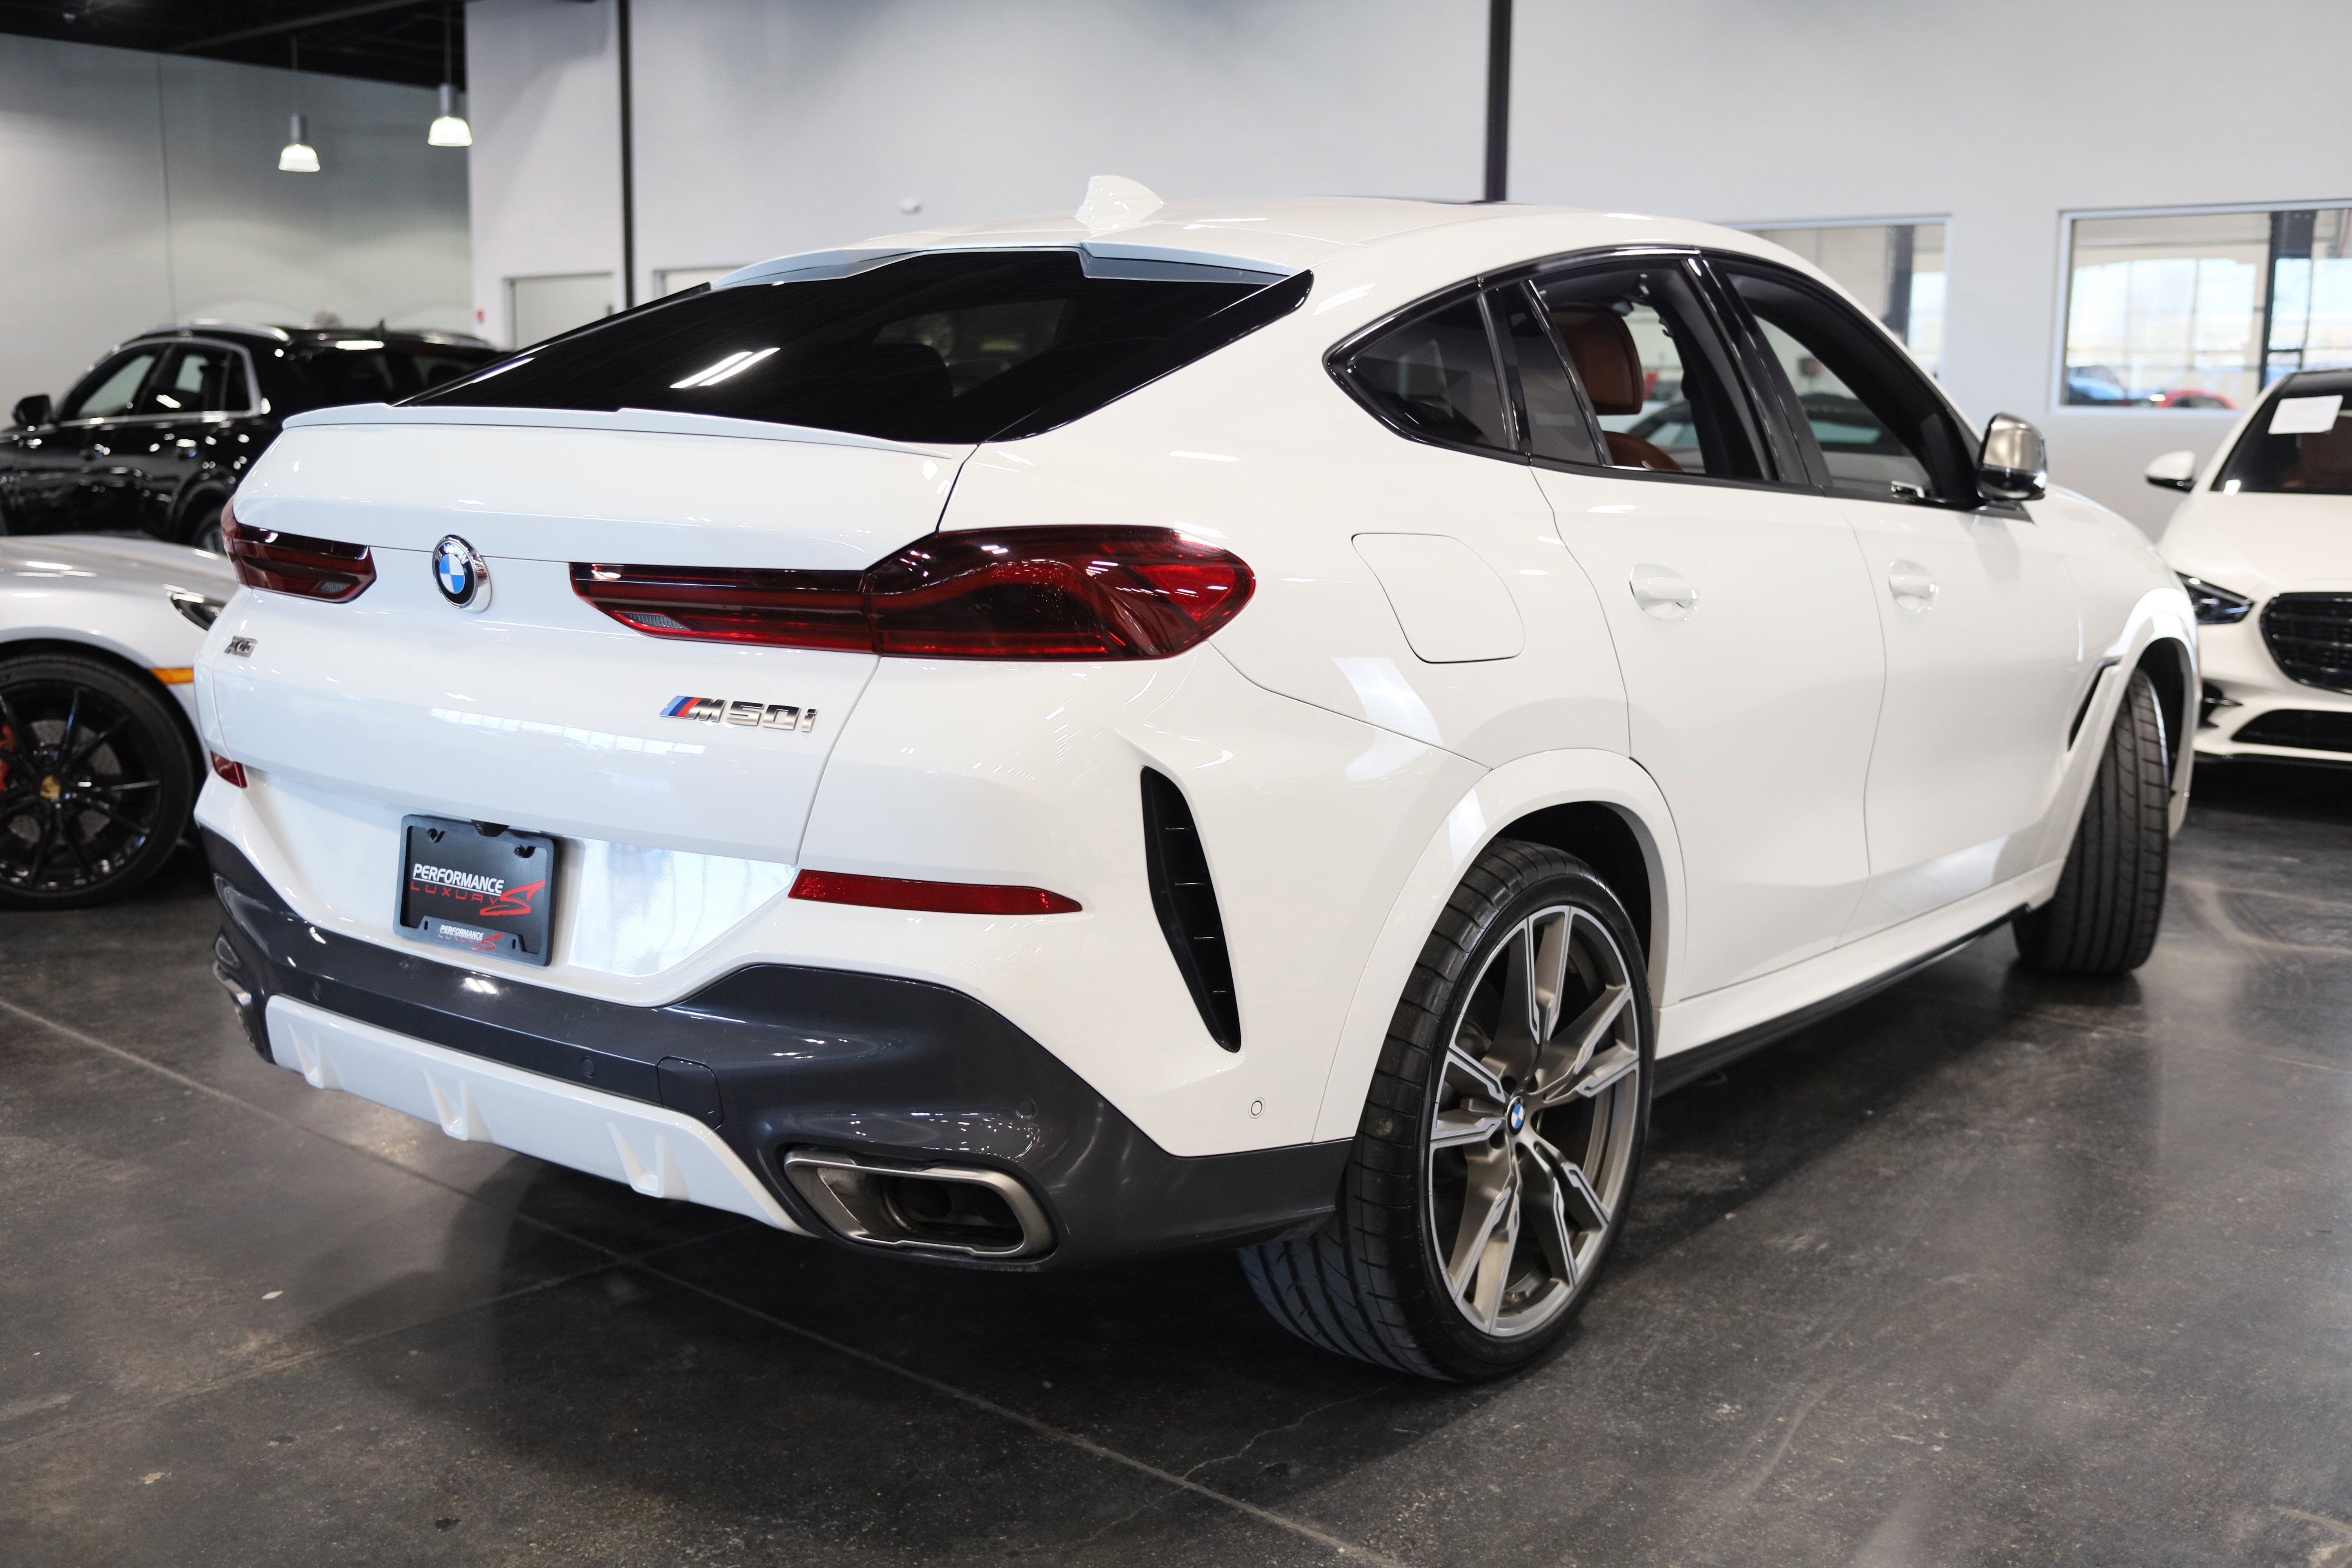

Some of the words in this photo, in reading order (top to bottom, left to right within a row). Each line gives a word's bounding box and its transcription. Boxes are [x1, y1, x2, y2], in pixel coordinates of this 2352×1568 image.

[684, 697, 818, 733] M50i
[413, 863, 504, 894] PERFORMANCE
[440, 924, 484, 940] PERFORMANCE
